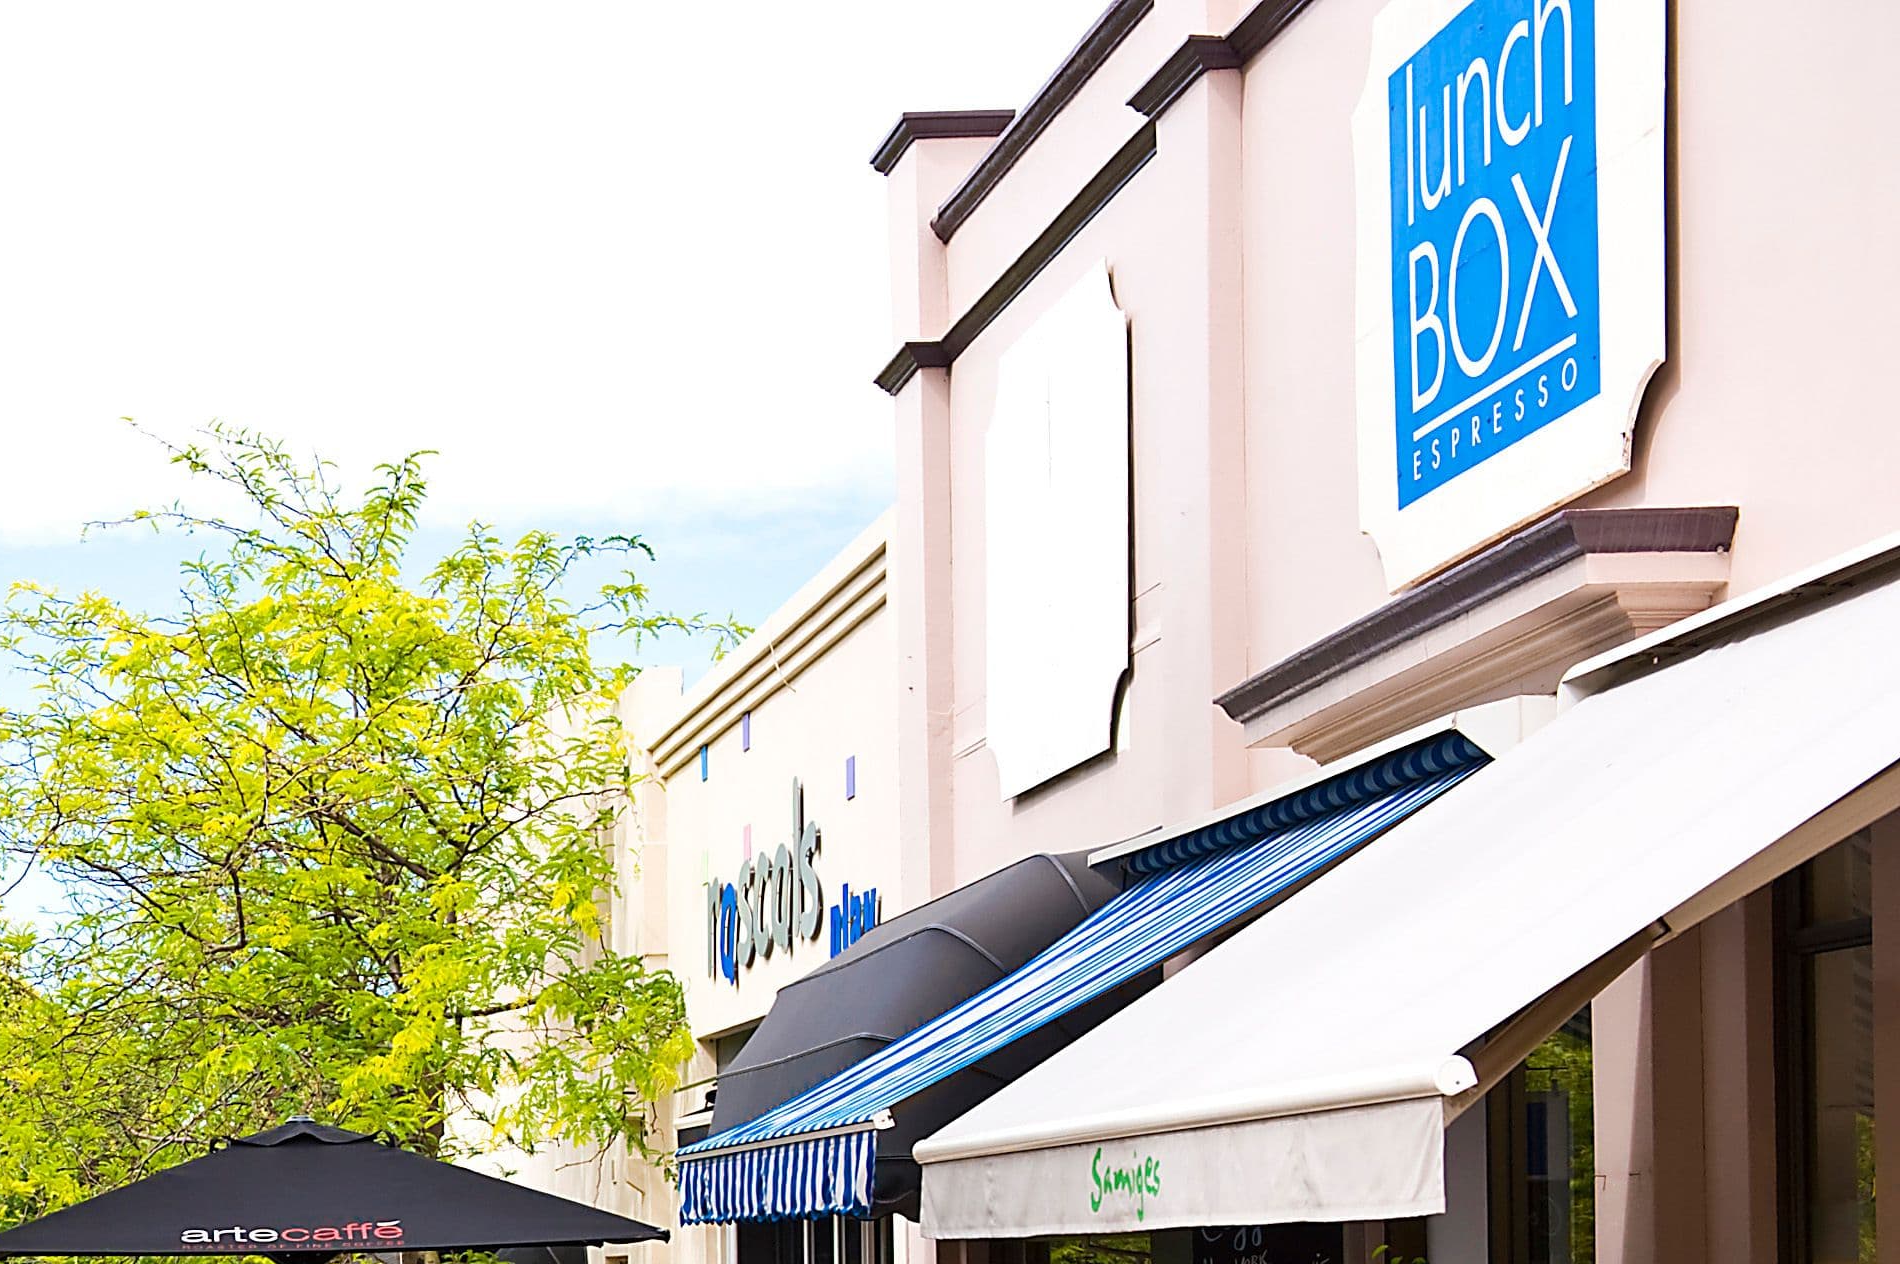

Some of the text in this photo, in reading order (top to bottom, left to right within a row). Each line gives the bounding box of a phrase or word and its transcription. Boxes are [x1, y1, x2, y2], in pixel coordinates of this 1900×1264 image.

[1406, 0, 1573, 226] lunch
[1408, 135, 1578, 415] BOX
[1413, 357, 1578, 482] ESPRESSO
[707, 775, 821, 987] rascals
